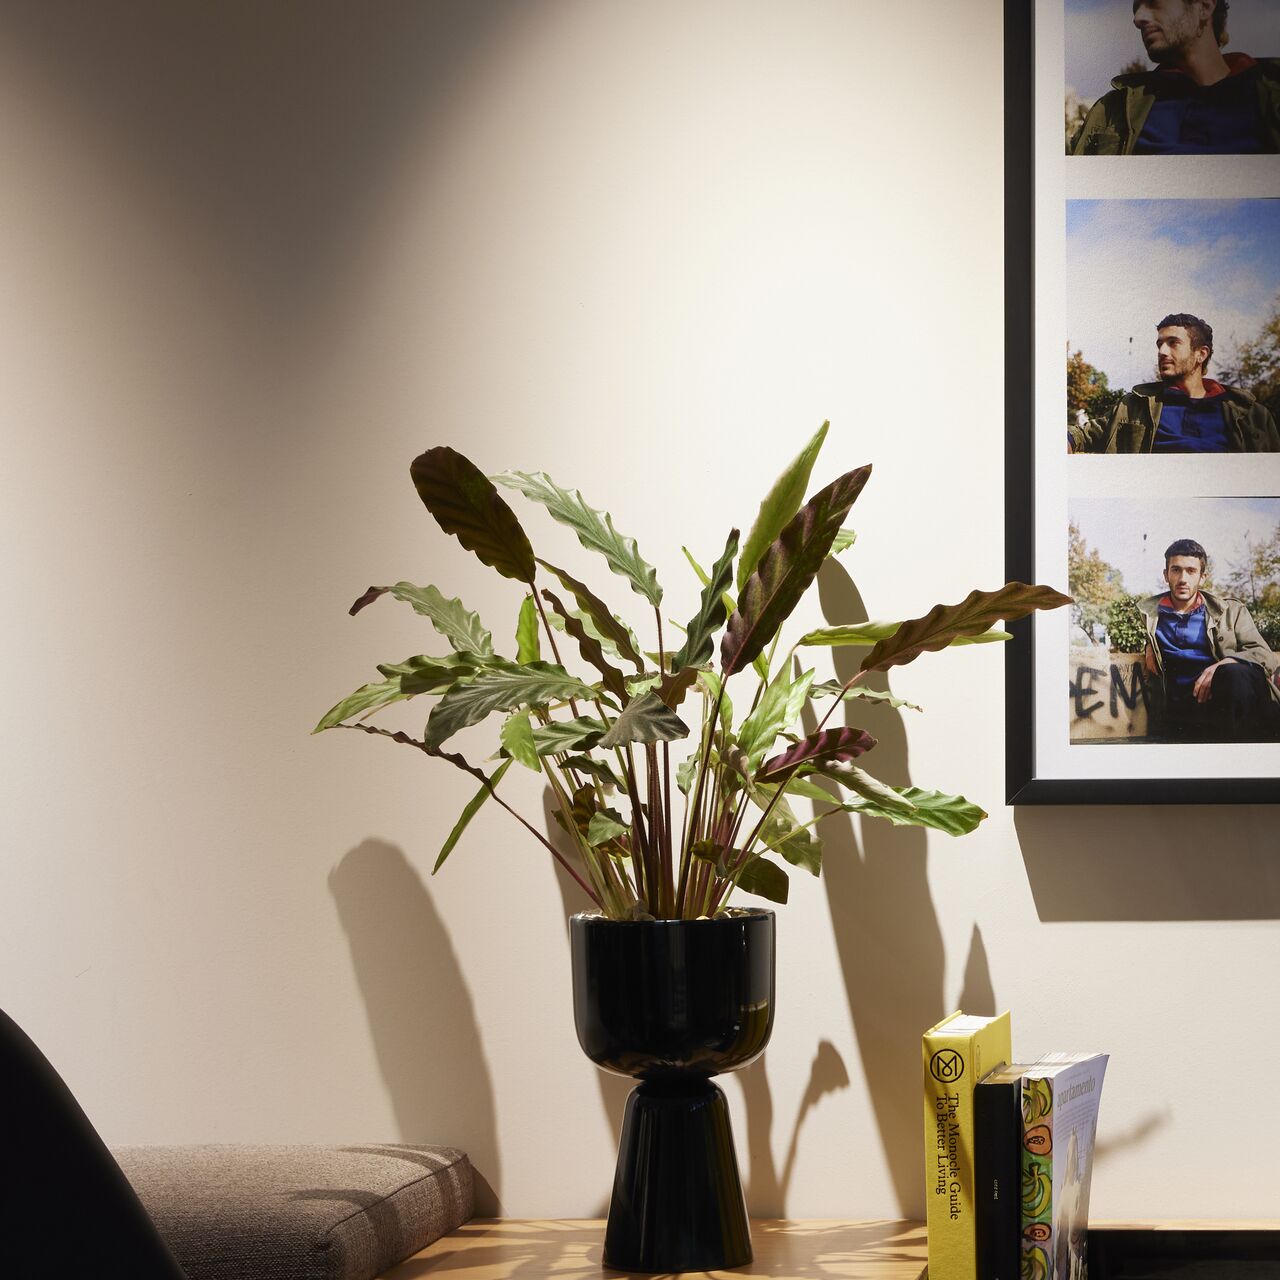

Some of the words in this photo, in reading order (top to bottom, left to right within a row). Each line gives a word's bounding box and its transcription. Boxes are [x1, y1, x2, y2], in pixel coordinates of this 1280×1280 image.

[936, 1095, 948, 1110] To
[948, 1092, 959, 1119] The
[936, 1114, 948, 1150] Better
[949, 1124, 960, 1178] Monocle
[935, 1154, 949, 1195] Living
[949, 1182, 962, 1221] Guide
